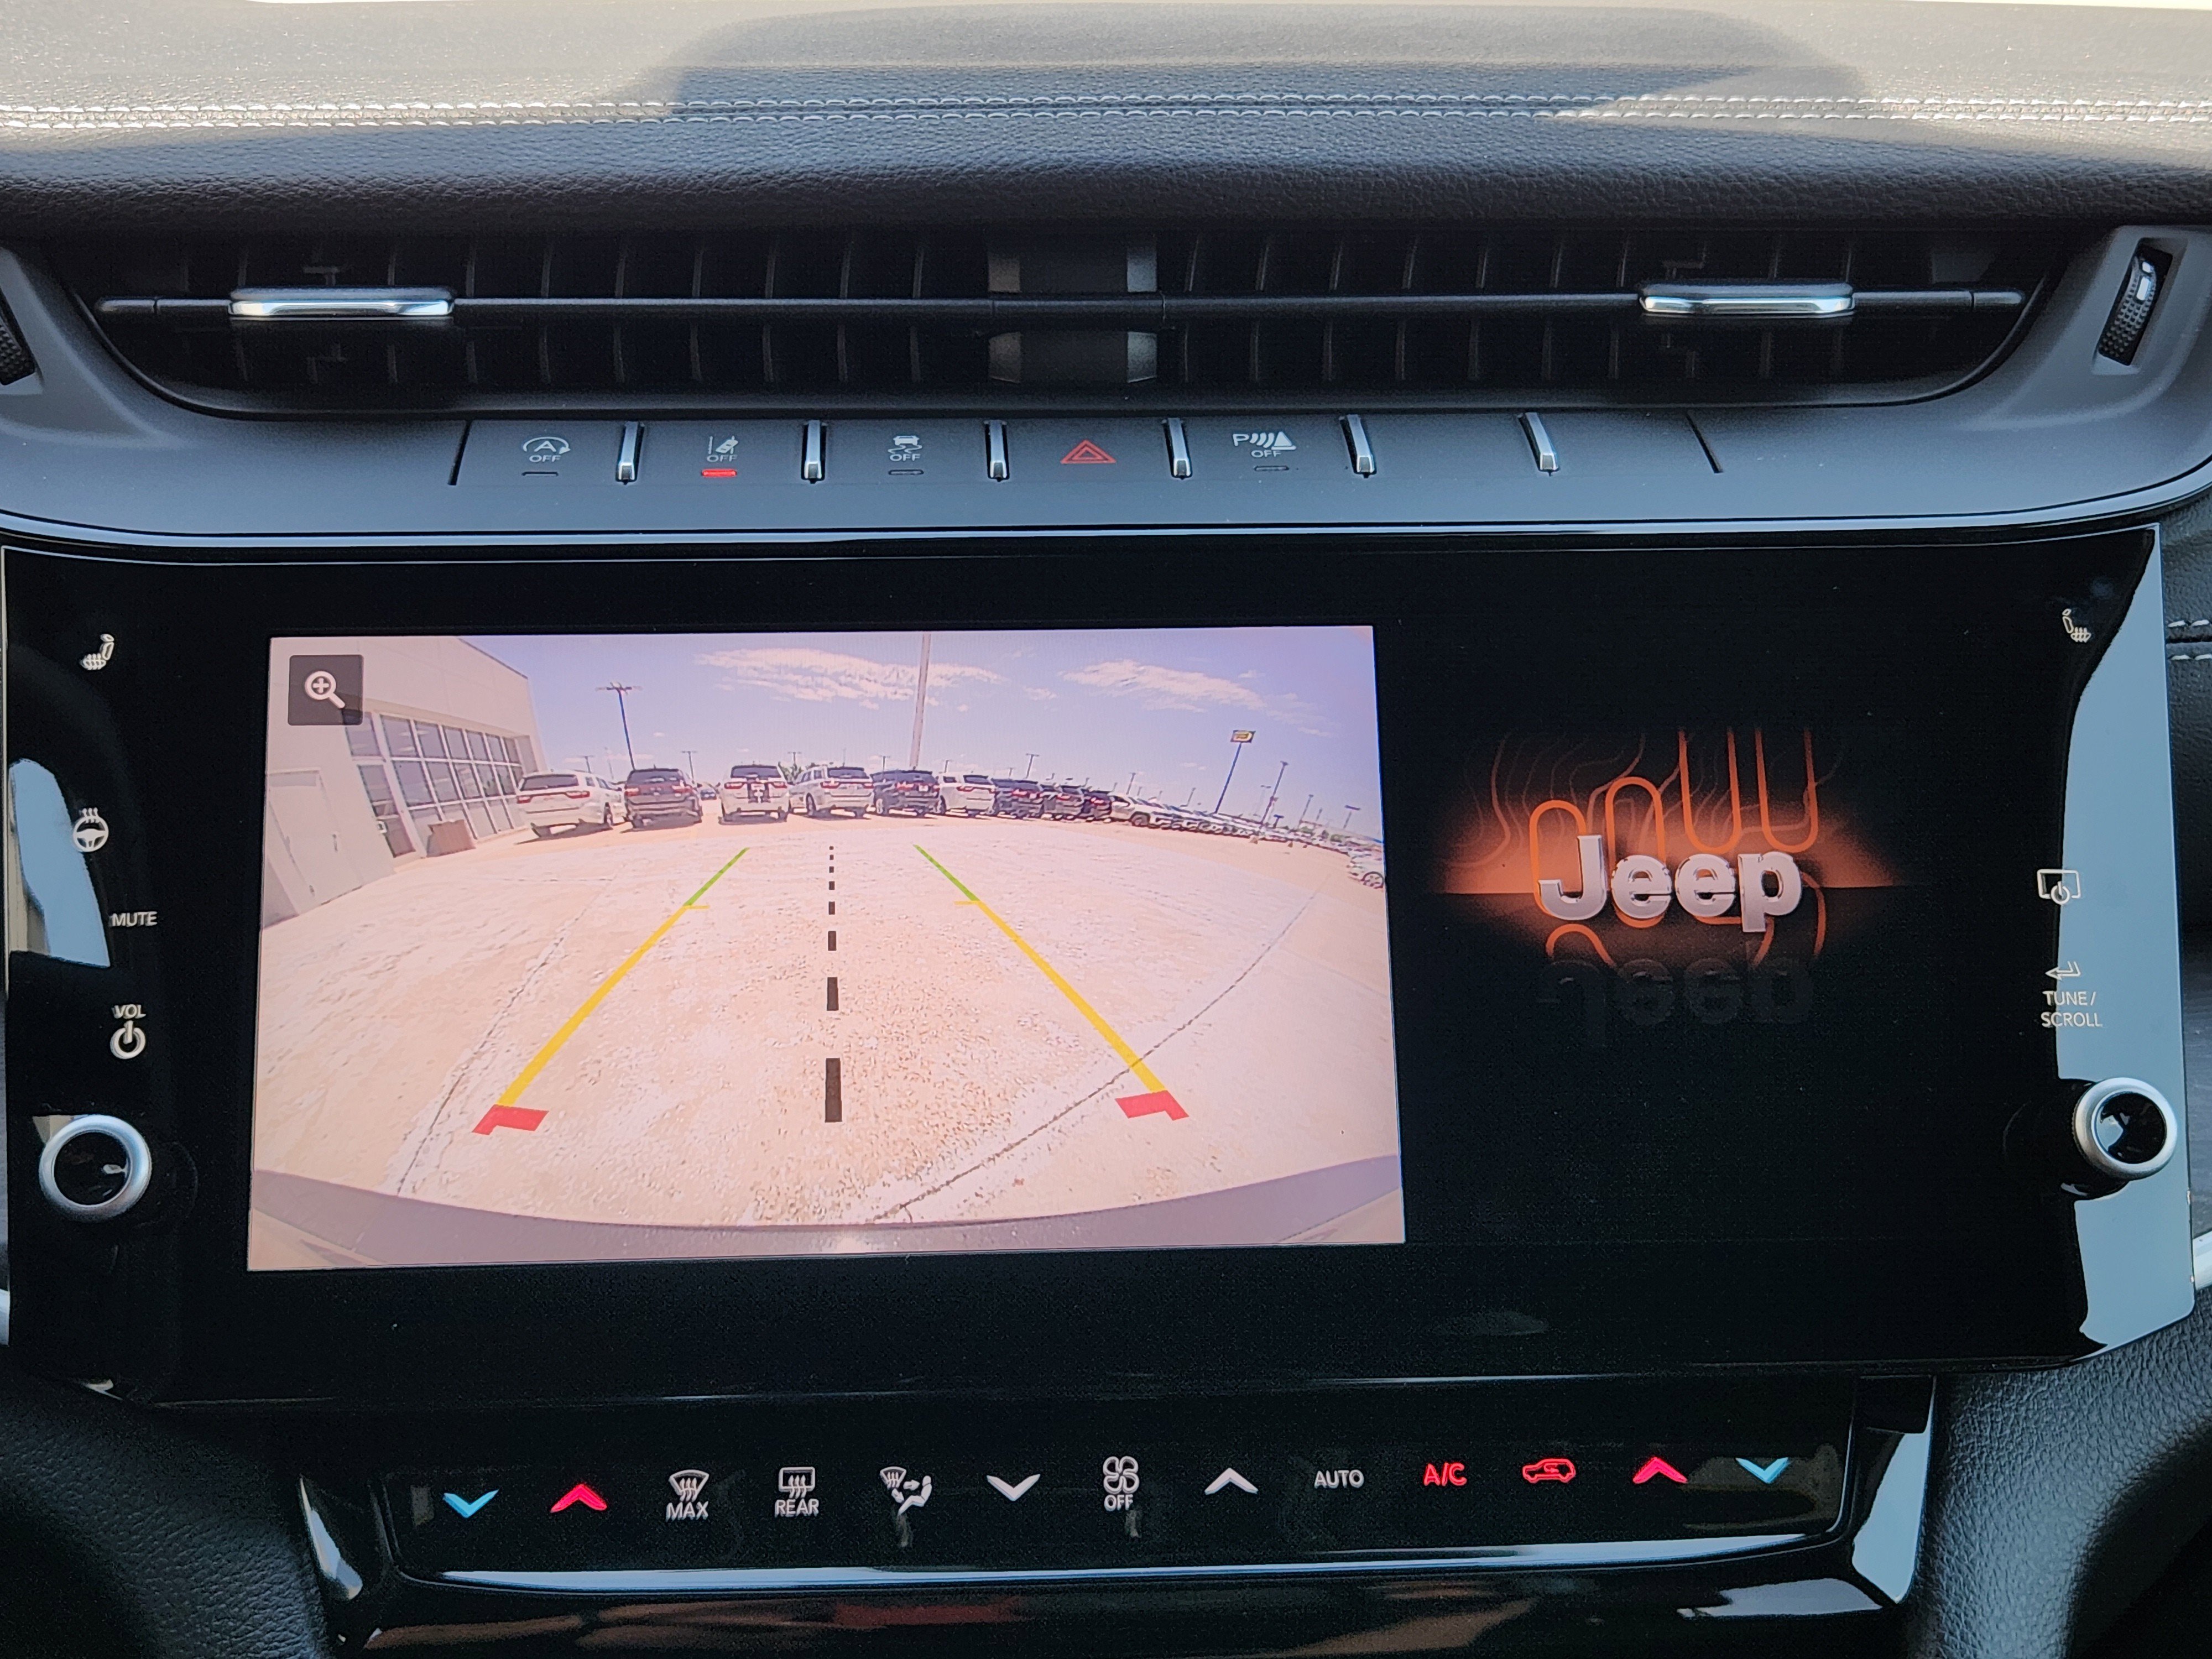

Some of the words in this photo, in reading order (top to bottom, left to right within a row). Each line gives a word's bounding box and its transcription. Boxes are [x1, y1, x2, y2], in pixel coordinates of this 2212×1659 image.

[1232, 434, 1250, 446] P
[889, 453, 921, 462] OFF
[1251, 450, 1282, 458] OFF
[1537, 834, 1803, 933] Jeep
[110, 911, 158, 927] MUTE
[2042, 990, 2096, 1006] TUNE/
[112, 1004, 147, 1019] VOL
[2040, 1011, 2103, 1028] SCROLL
[1314, 1469, 1364, 1489] AUTO
[1423, 1462, 1467, 1486] A/C
[666, 1500, 709, 1521] MAX
[774, 1498, 820, 1517] REAR
[1104, 1494, 1134, 1511] OFF
